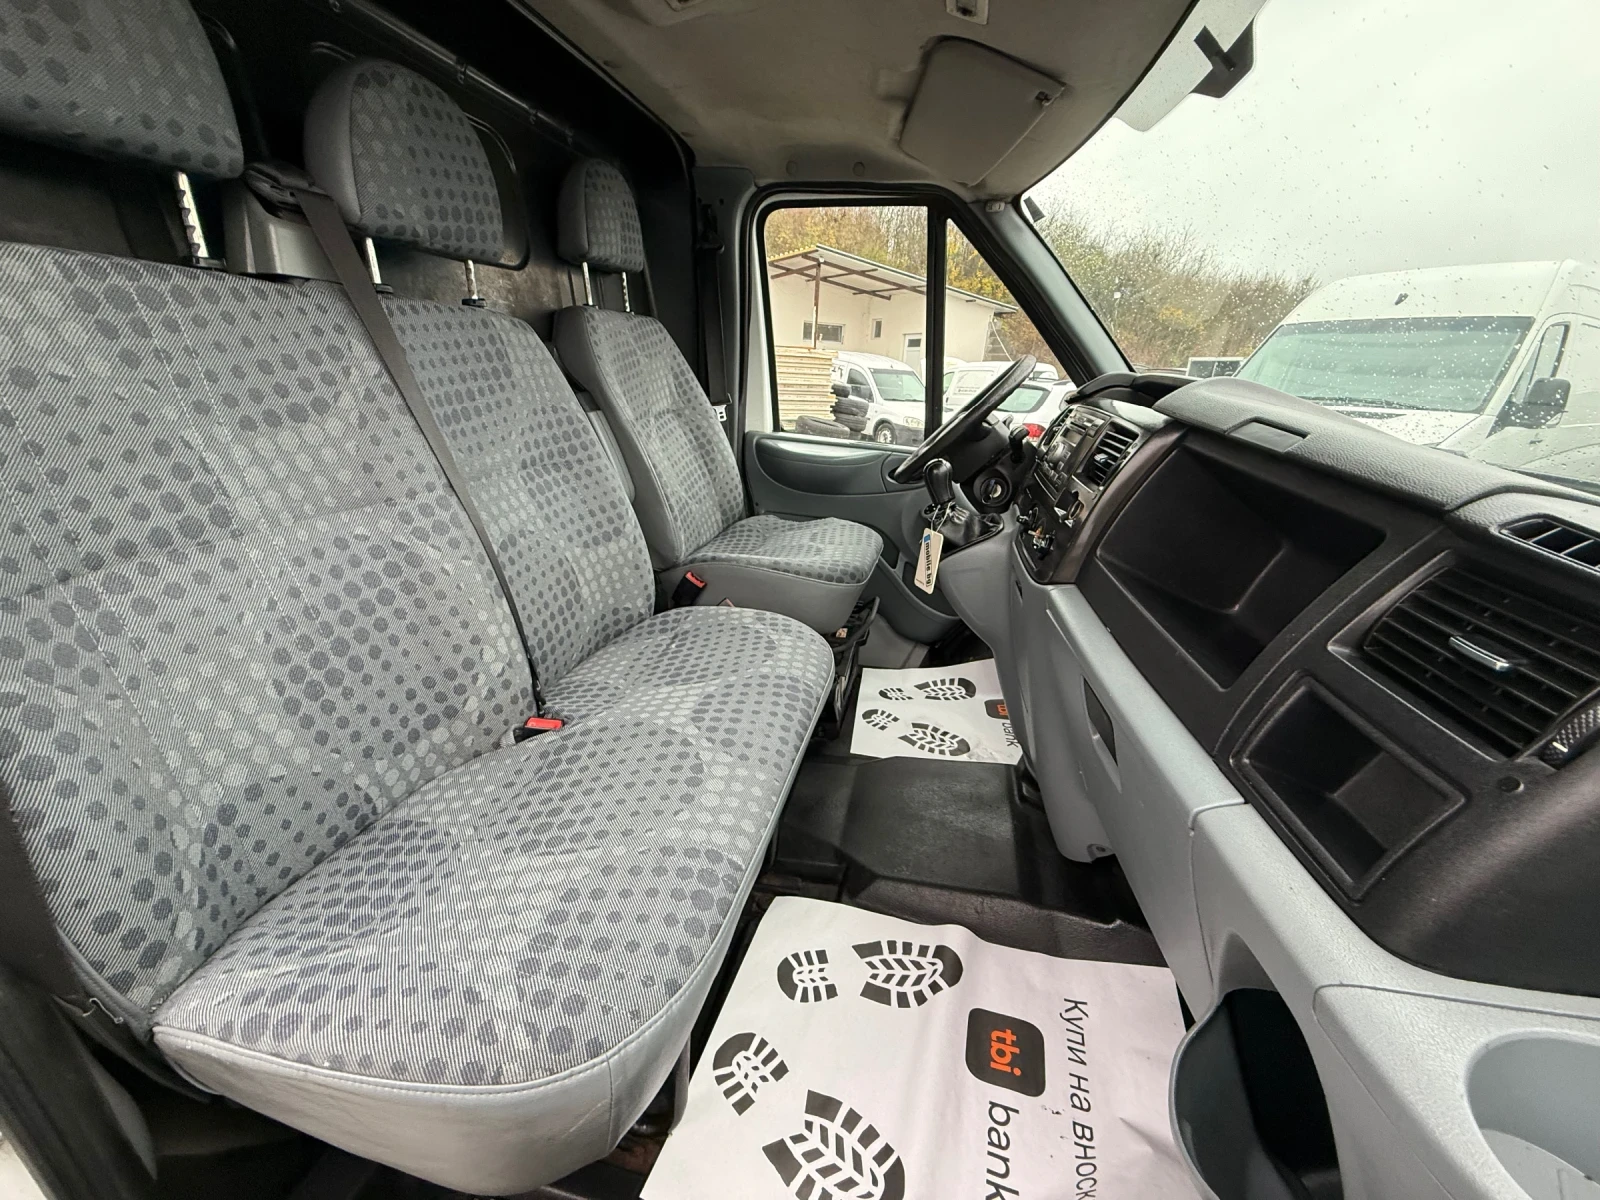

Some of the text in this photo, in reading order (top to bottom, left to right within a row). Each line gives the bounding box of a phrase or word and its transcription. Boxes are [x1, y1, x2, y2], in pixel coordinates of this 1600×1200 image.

[1060, 998, 1089, 1066] Купи
[985, 1028, 1021, 1200] tbi bank
[1069, 1072, 1092, 1113] на
